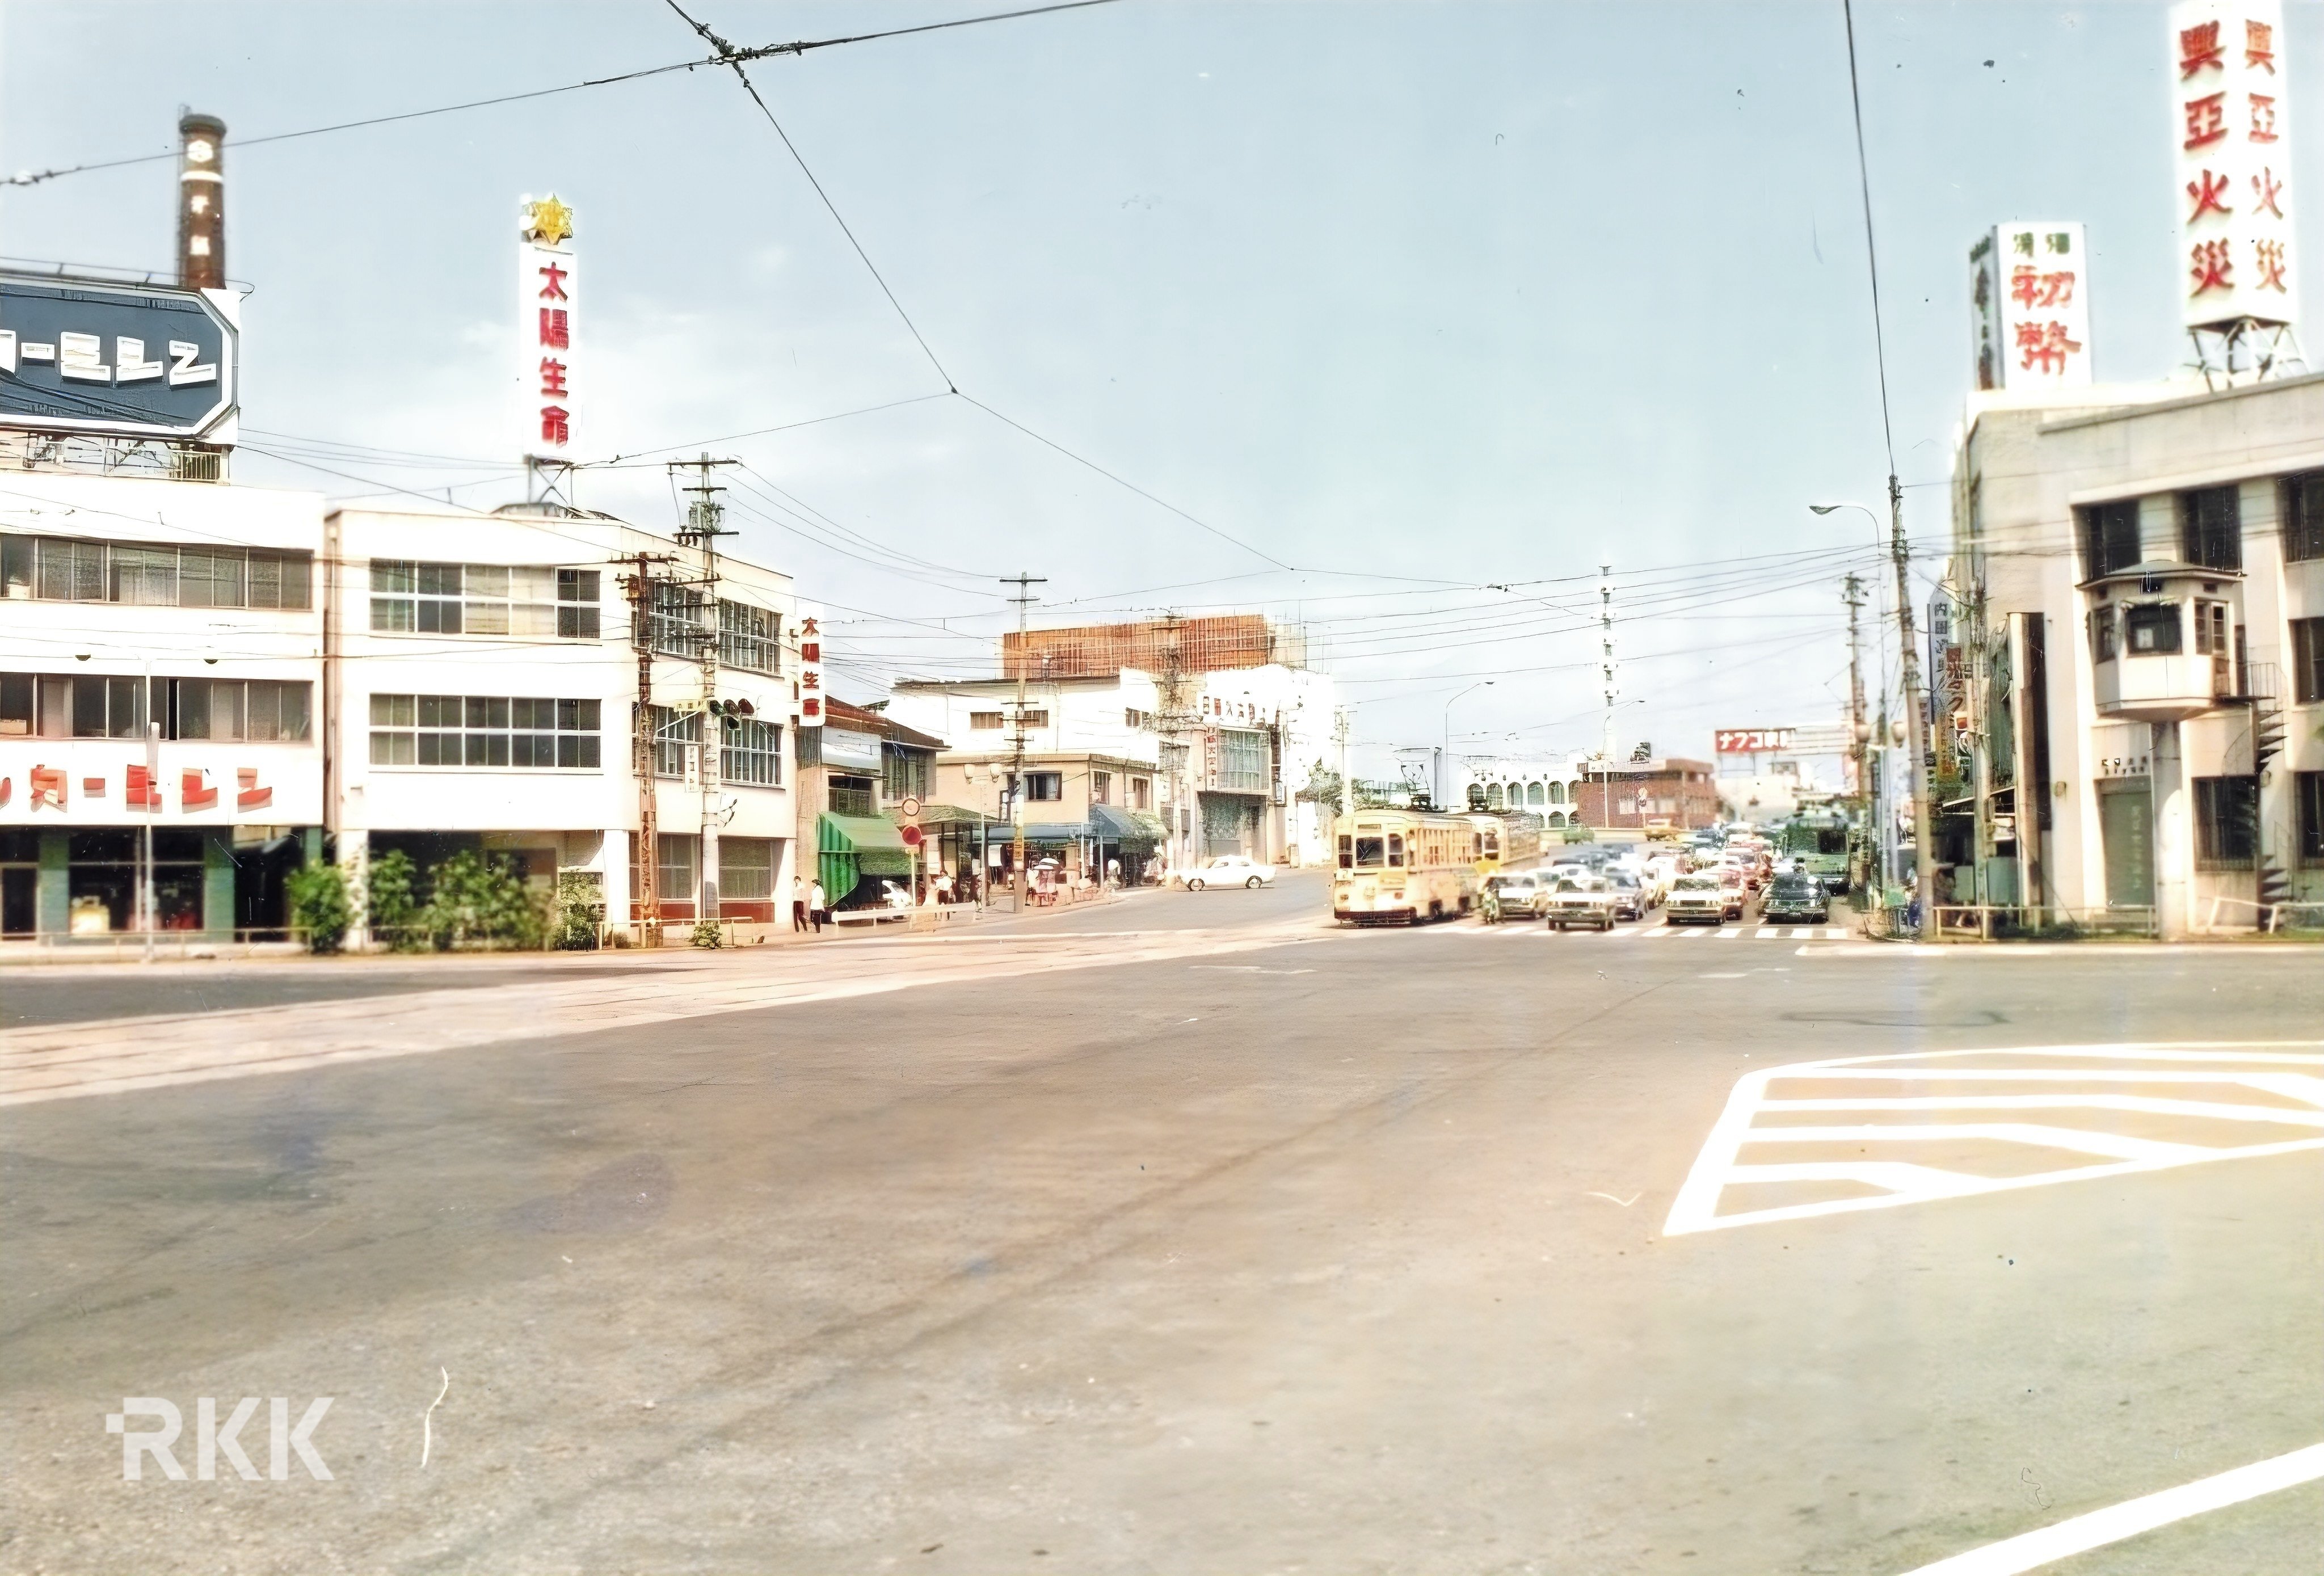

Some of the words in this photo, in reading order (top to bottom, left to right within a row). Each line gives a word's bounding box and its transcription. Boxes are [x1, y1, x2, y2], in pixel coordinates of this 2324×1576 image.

[801, 616, 820, 718] 太生
[1719, 731, 1787, 749] ナフコ
